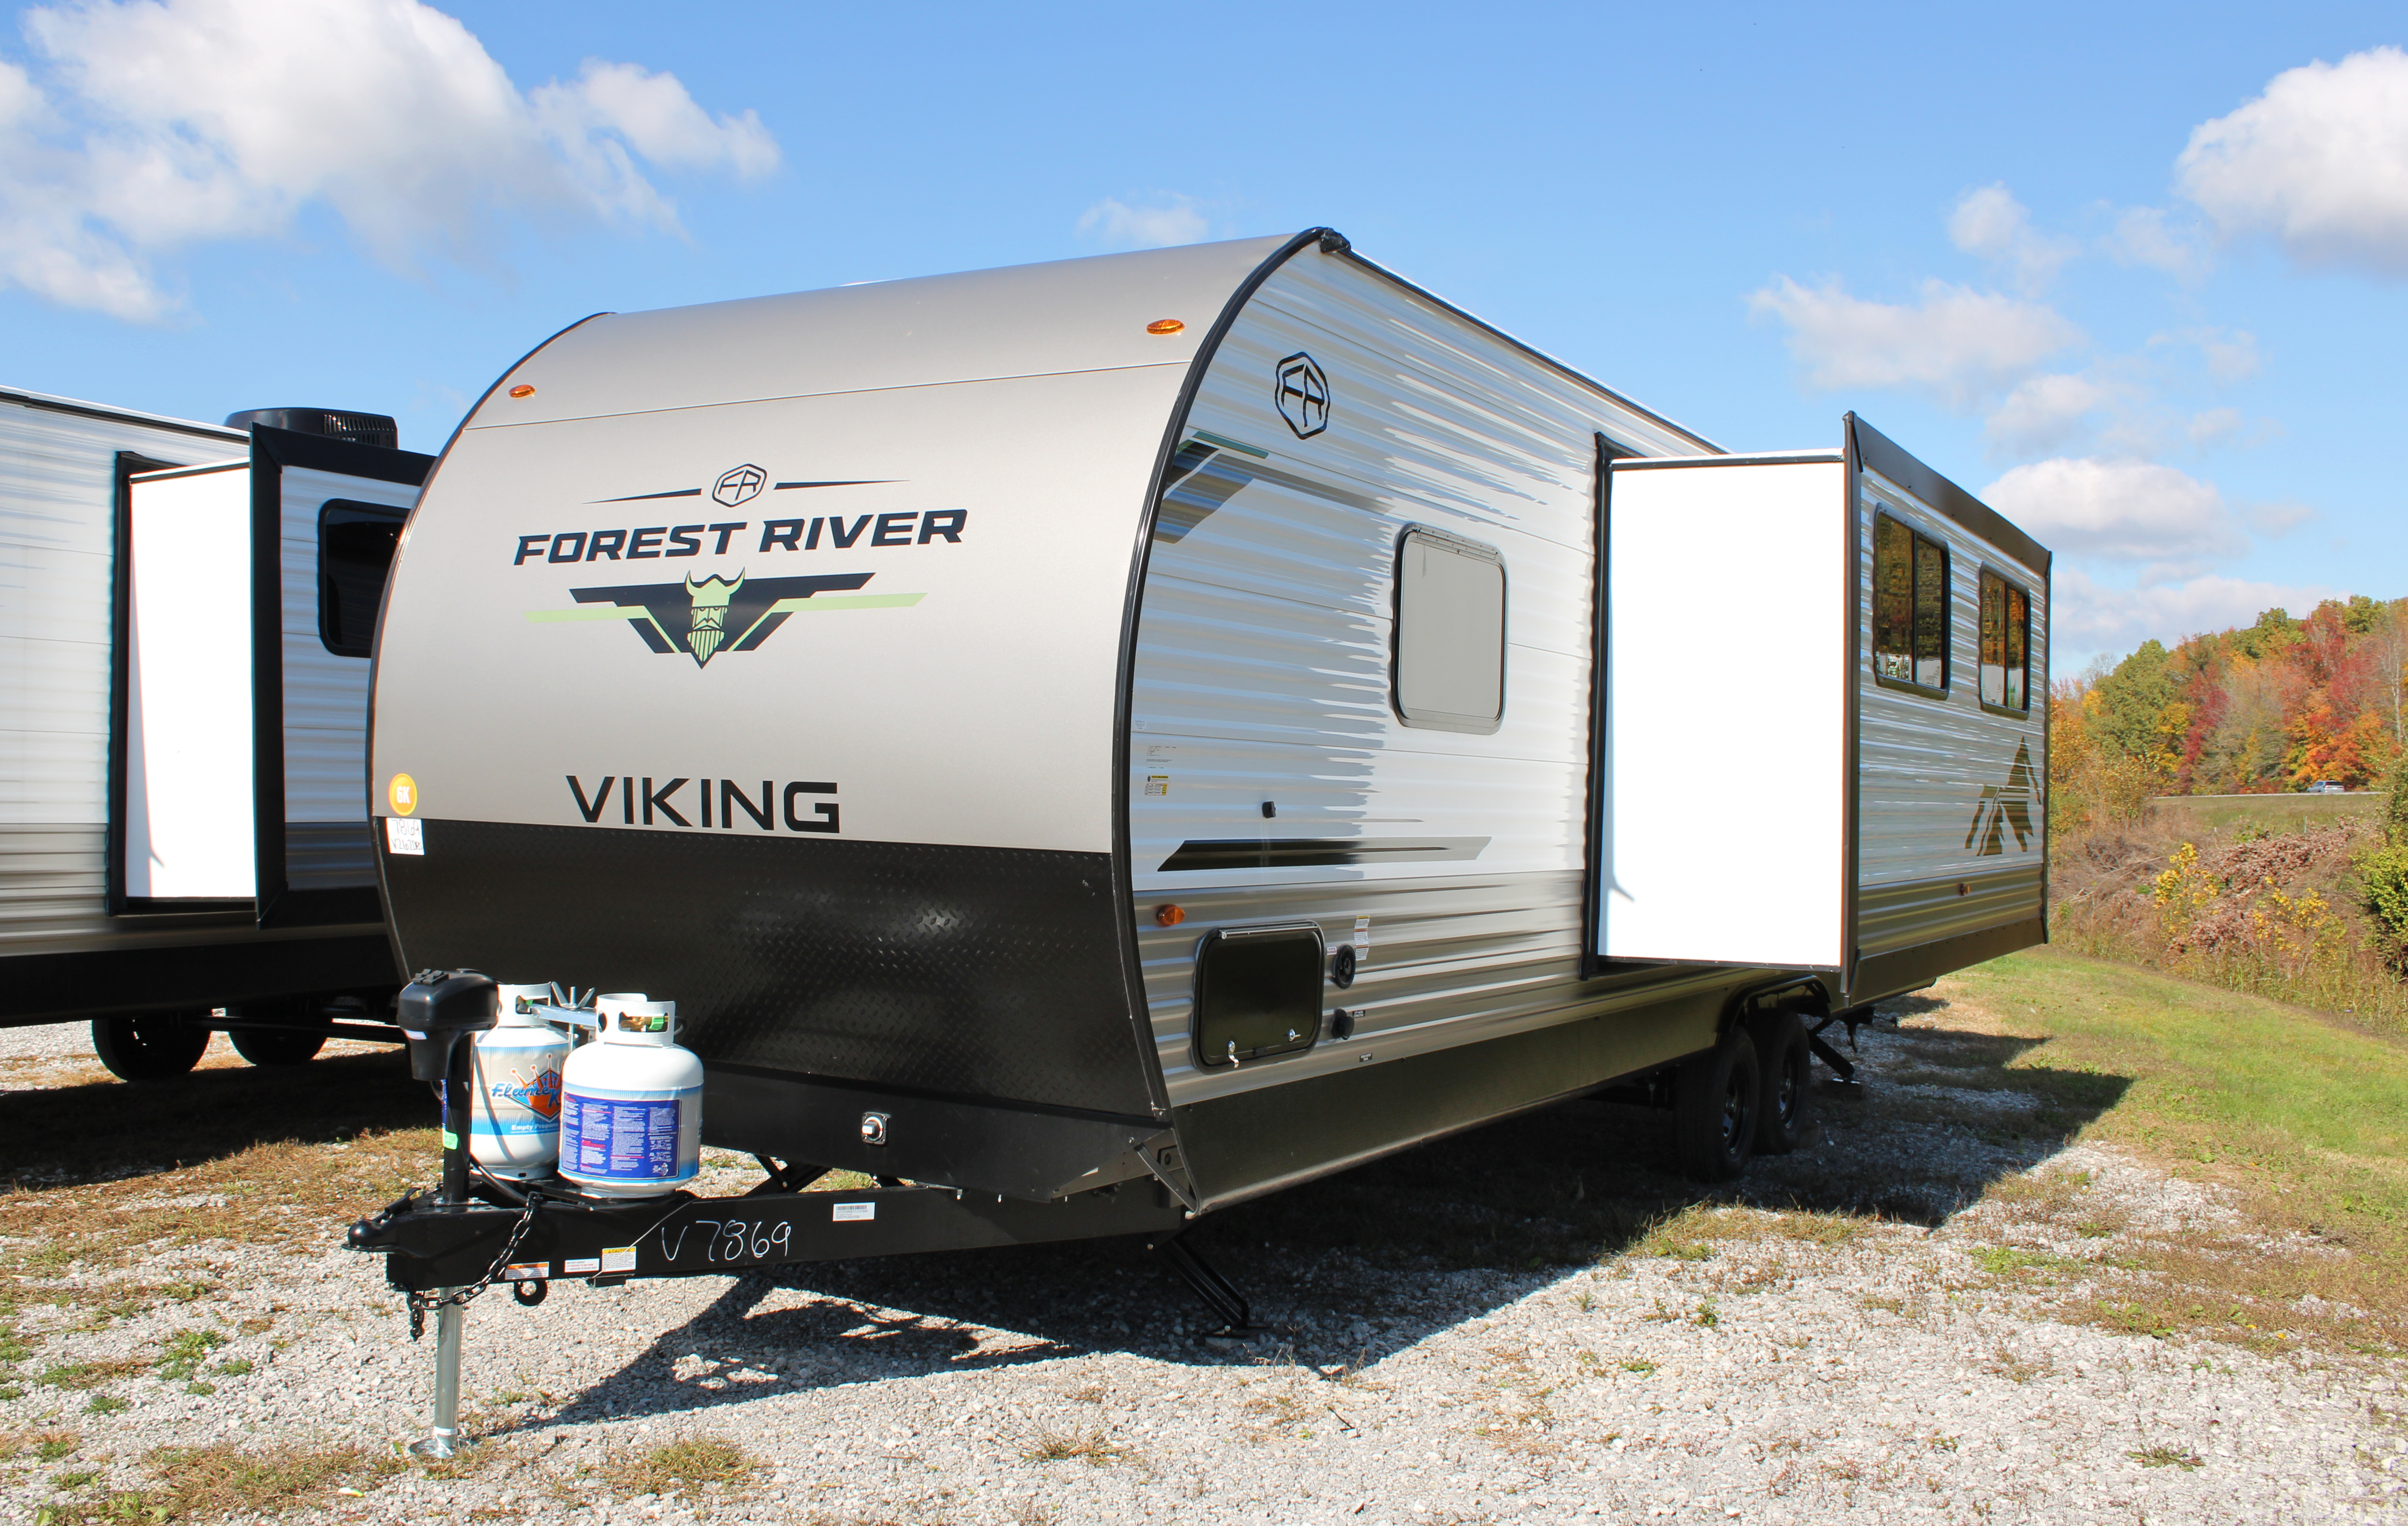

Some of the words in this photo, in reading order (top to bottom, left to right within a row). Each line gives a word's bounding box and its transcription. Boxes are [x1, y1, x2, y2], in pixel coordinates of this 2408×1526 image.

[513, 522, 747, 566] FOREST
[759, 509, 968, 553] RIVER
[396, 786, 411, 804] 6K
[566, 775, 840, 833] VIKING
[391, 819, 420, 836] 7869
[491, 1083, 549, 1097] Flame
[661, 1225, 688, 1262] V
[695, 1219, 792, 1262] 7869
